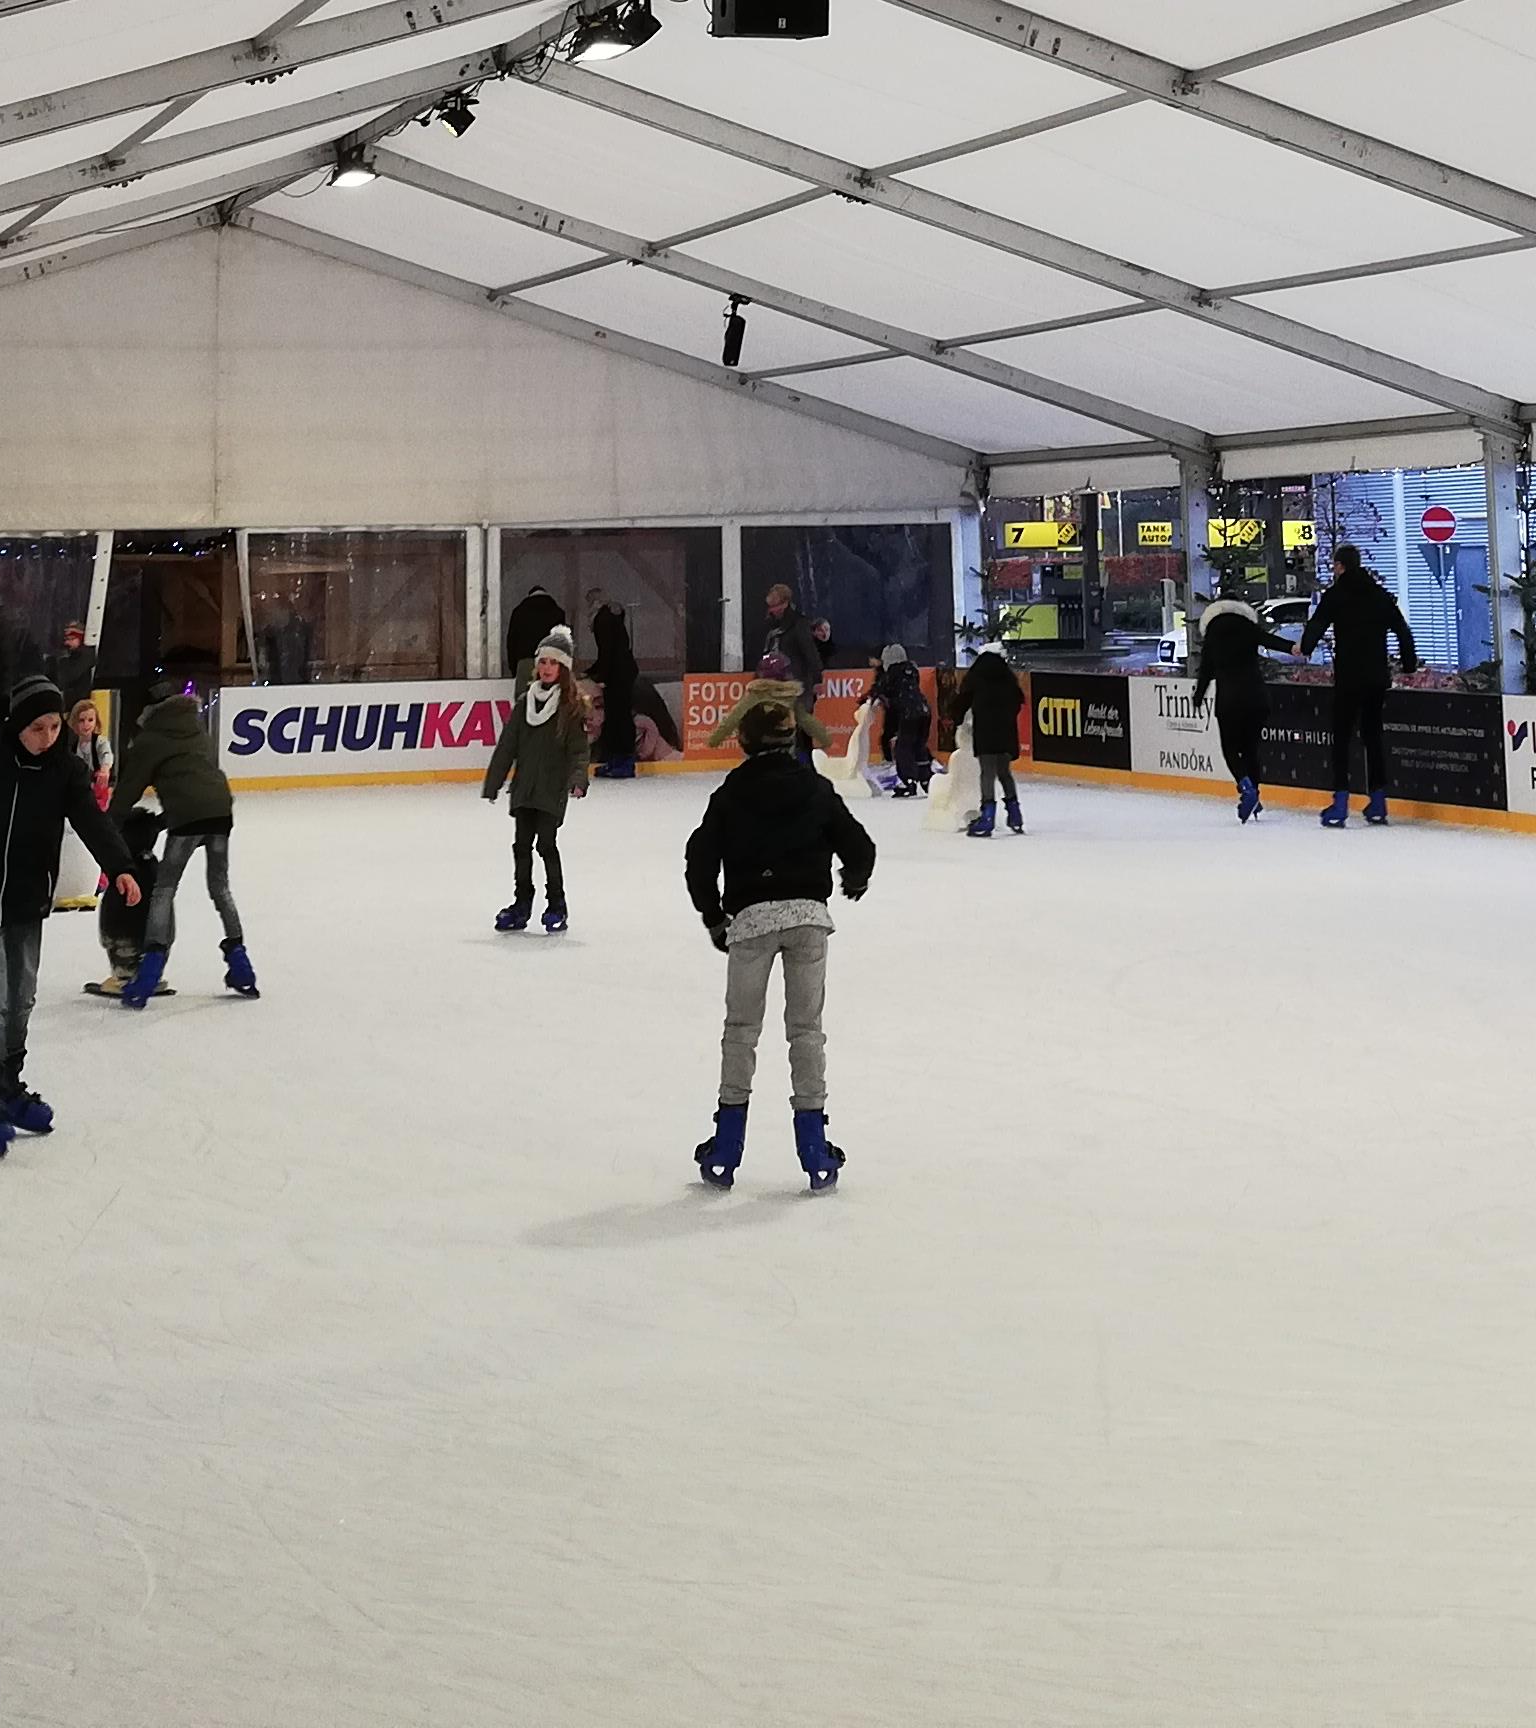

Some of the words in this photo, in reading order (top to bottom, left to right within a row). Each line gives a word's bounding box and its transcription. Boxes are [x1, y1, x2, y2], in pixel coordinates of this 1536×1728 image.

[1011, 527, 1025, 544] 7
[688, 680, 753, 701] FOTO
[816, 679, 863, 699] NK?
[1038, 696, 1081, 738] CITTI
